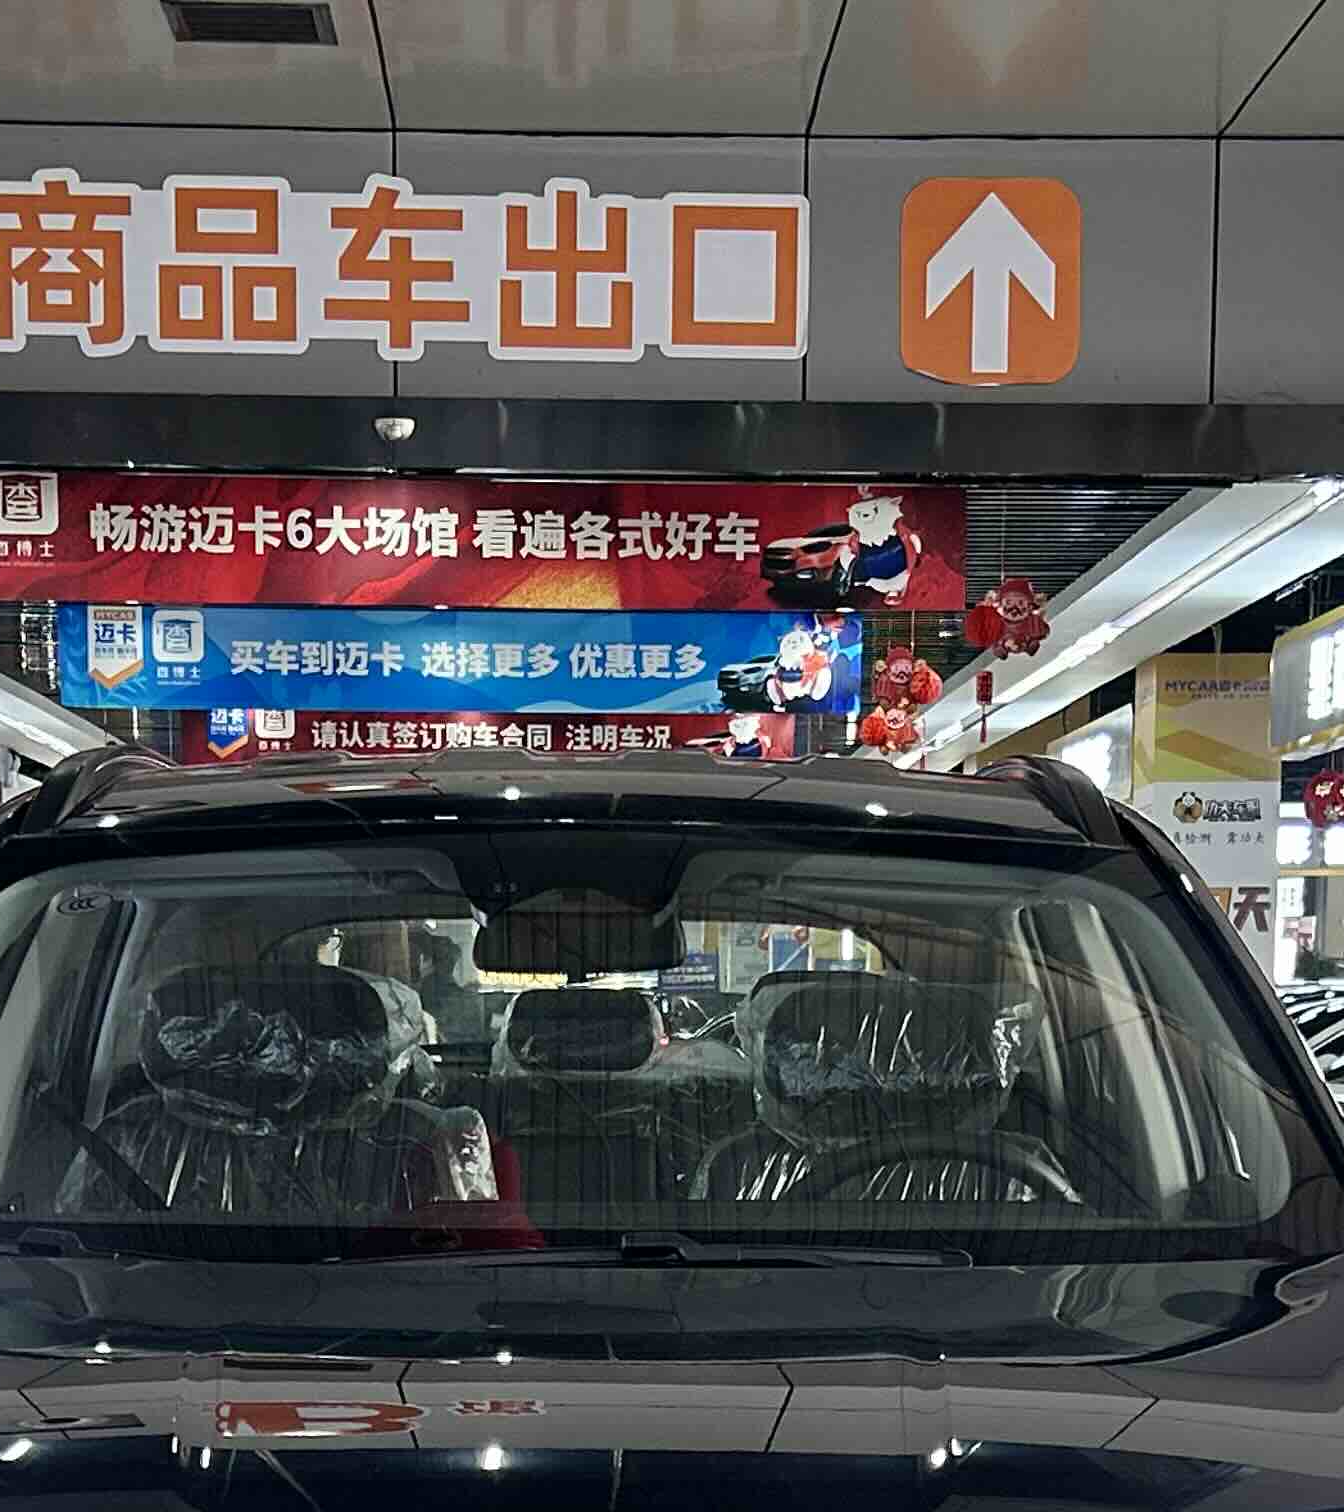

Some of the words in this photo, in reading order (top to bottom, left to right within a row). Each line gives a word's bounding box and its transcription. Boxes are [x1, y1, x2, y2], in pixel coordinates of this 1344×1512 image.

[89, 502, 459, 558] 畅游迈卡6大场馆
[472, 509, 760, 562] 看遍各式好车
[94, 622, 137, 644] 迈卡
[230, 640, 405, 676] 买车到迈卡
[421, 641, 560, 679] 选择更多
[569, 643, 707, 679] 优惠更多
[311, 719, 553, 752] 请认真签订购车合同
[564, 723, 673, 752] 注明车况
